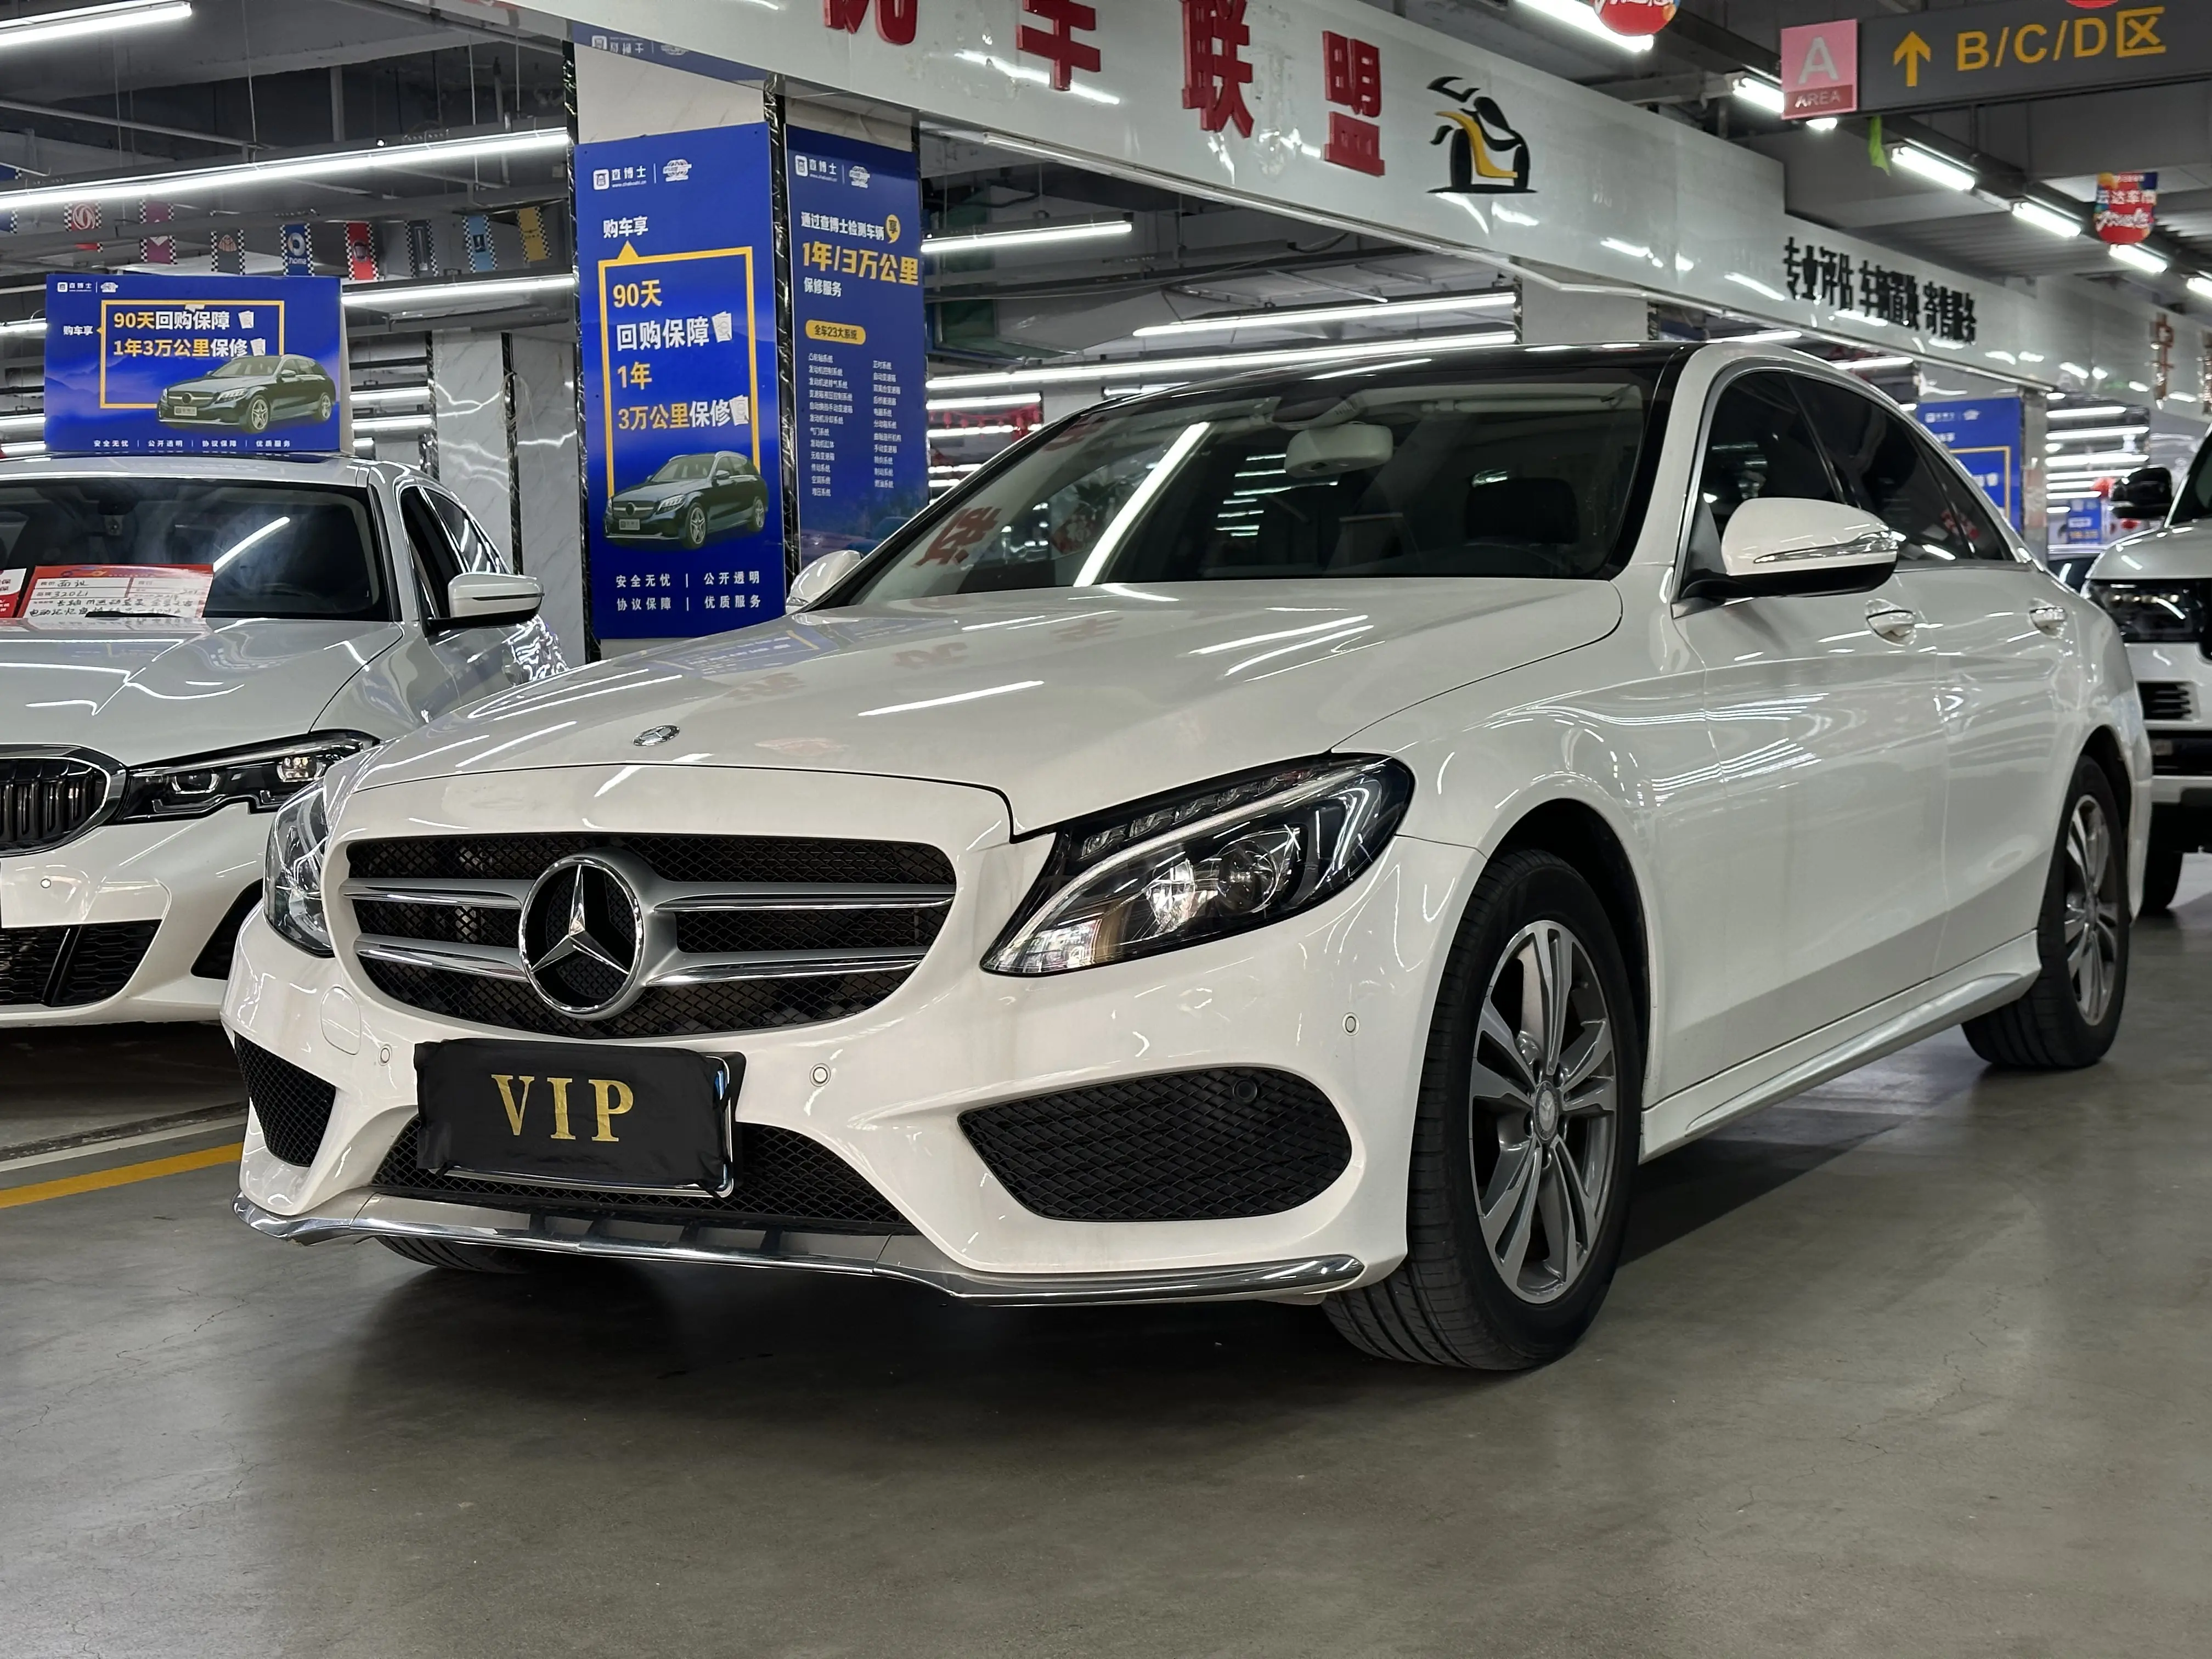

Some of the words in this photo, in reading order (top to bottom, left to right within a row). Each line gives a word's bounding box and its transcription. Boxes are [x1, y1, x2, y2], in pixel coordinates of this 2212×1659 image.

[1957, 7, 2166, 71] B/C/D区
[1798, 36, 1839, 85] A
[825, 0, 1385, 177] 车联盟
[1794, 90, 1842, 109] AREA
[612, 165, 647, 180] 查博士
[603, 216, 648, 238] 购车享
[801, 211, 884, 241] 通过查博士检测车辆
[803, 241, 919, 285] 1年/3万公里
[613, 279, 663, 308] 90天
[804, 277, 842, 297] 保修服务
[63, 326, 93, 336] 购车享
[114, 311, 230, 330] 90天回购保障
[616, 316, 710, 352] 回购保障
[814, 325, 857, 340] 全车23大系统
[114, 338, 248, 357] 1年3万公里保修
[617, 362, 652, 390] 1年
[618, 399, 731, 431] 3万公里保修
[93, 439, 129, 448] 安全无忧
[256, 439, 290, 448] 优质服务
[616, 573, 671, 588] 安全无忧
[704, 571, 760, 586] 公开透明
[617, 597, 672, 612] 协议保障
[704, 595, 761, 610] 优质服务
[491, 1074, 634, 1142] VIP
